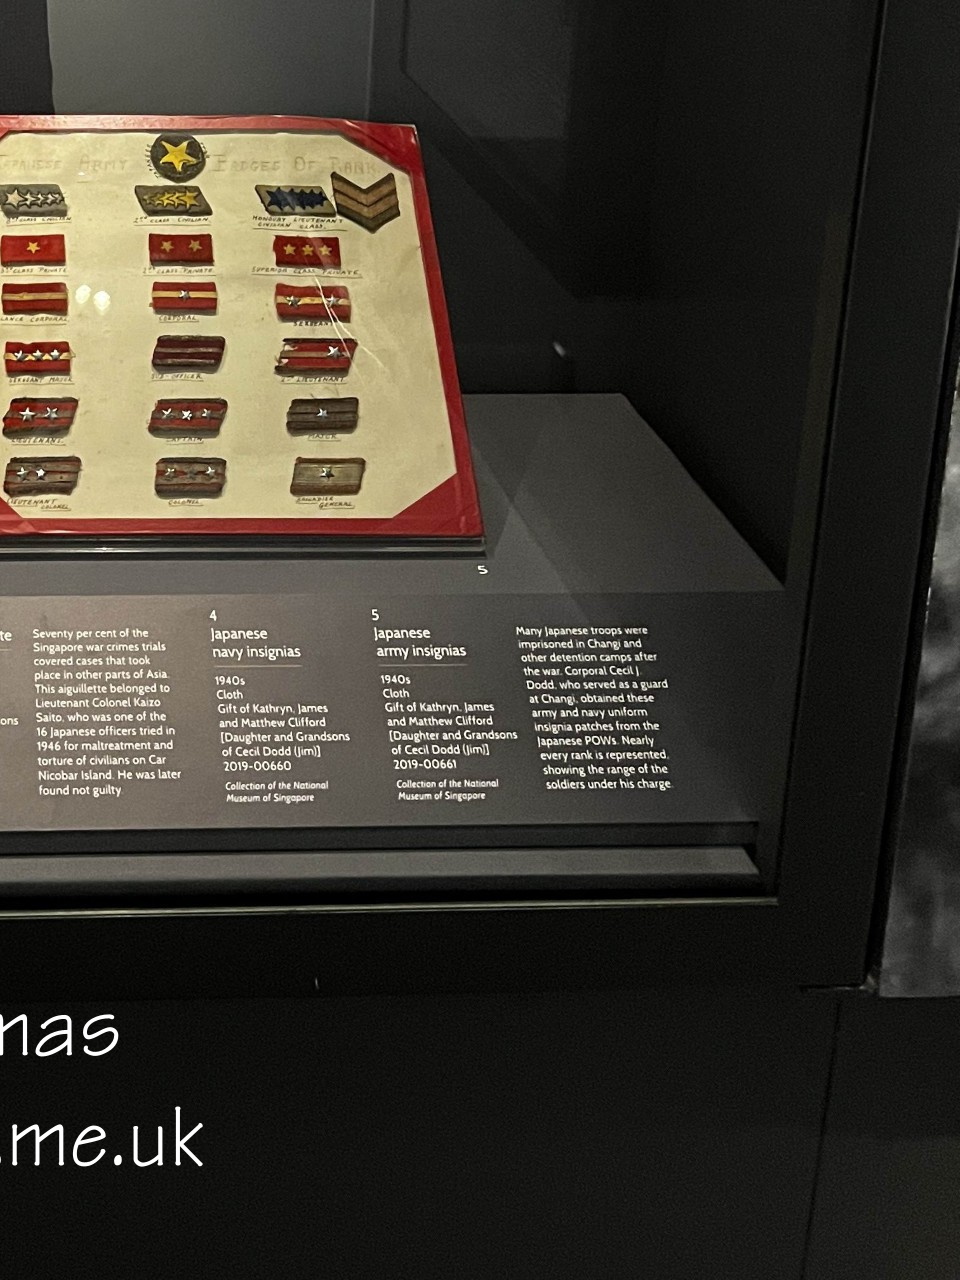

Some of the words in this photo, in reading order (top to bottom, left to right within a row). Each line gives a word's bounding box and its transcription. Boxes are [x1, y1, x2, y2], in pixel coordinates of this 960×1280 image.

[477, 565, 489, 575] 5
[209, 609, 218, 622] 4
[371, 608, 380, 622] 5
[32, 628, 74, 641] Seventy
[76, 630, 93, 641] per
[94, 629, 118, 638] cent
[118, 627, 130, 638] of
[131, 628, 149, 638] the
[210, 627, 268, 644] Japanese
[373, 626, 431, 643] Japanese
[515, 626, 543, 638] Many
[544, 625, 589, 638] Japanese
[589, 626, 623, 637] troops
[623, 627, 649, 635] were
[517, 638, 575, 652] imprisoned
[575, 639, 586, 649] in
[586, 638, 622, 651] Changi
[623, 637, 643, 649] and
[212, 648, 244, 662] navy
[246, 644, 302, 661] insignias
[376, 647, 410, 661] army
[411, 643, 467, 661] insignias
